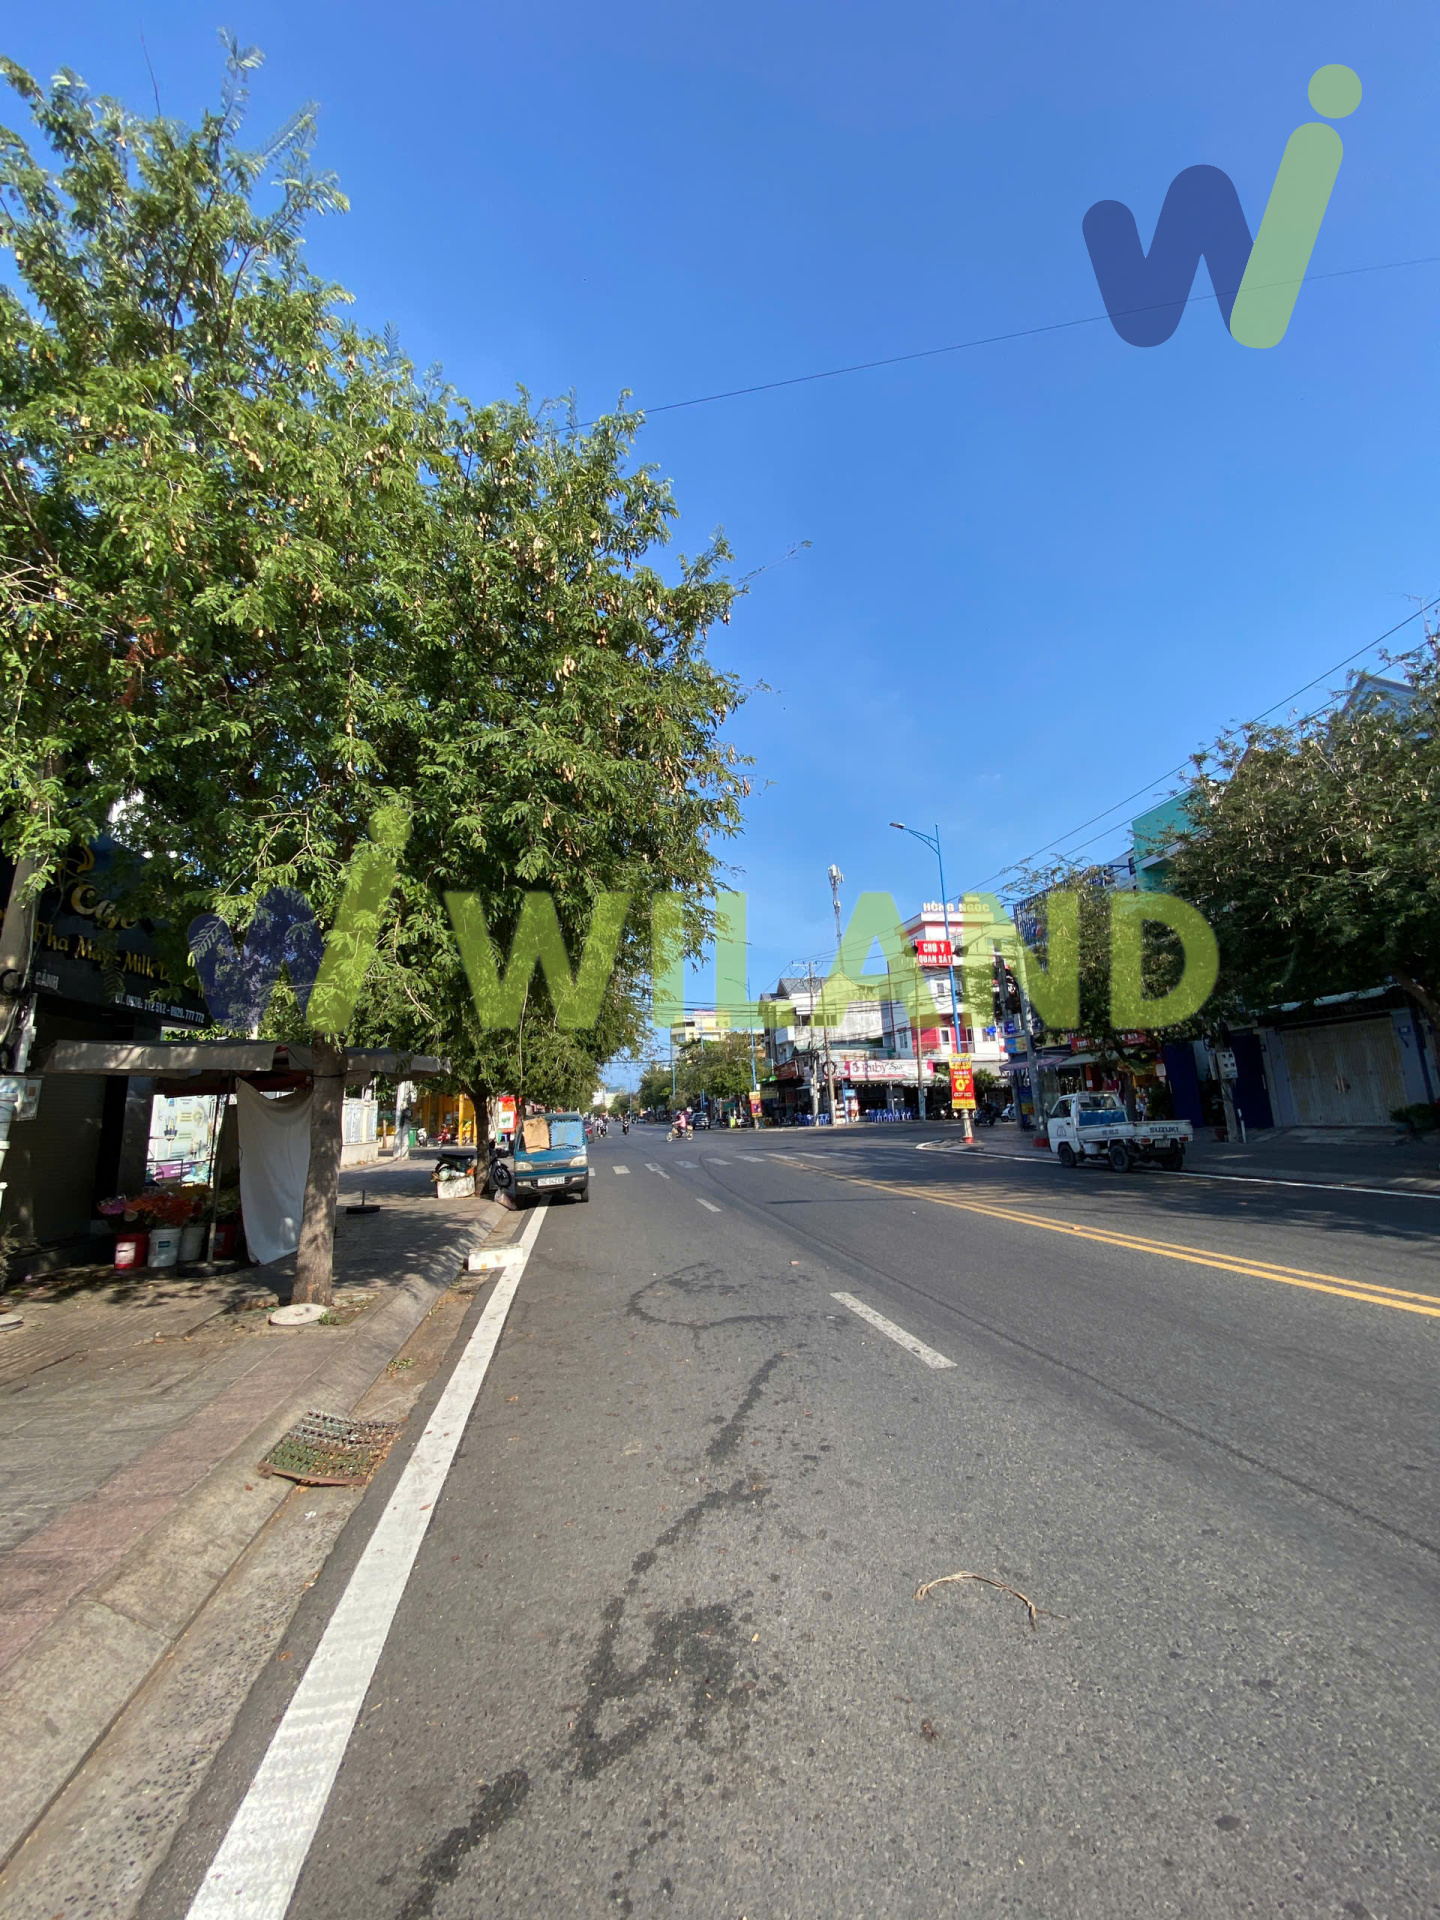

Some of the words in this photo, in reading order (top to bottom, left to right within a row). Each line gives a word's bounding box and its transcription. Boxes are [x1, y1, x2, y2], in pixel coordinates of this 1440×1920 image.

[923, 942, 938, 953] CHÚ
[940, 942, 945, 953] Ý
[919, 955, 937, 964] QUAN
[938, 954, 952, 963] SÁT
[862, 1062, 886, 1073] Ruby
